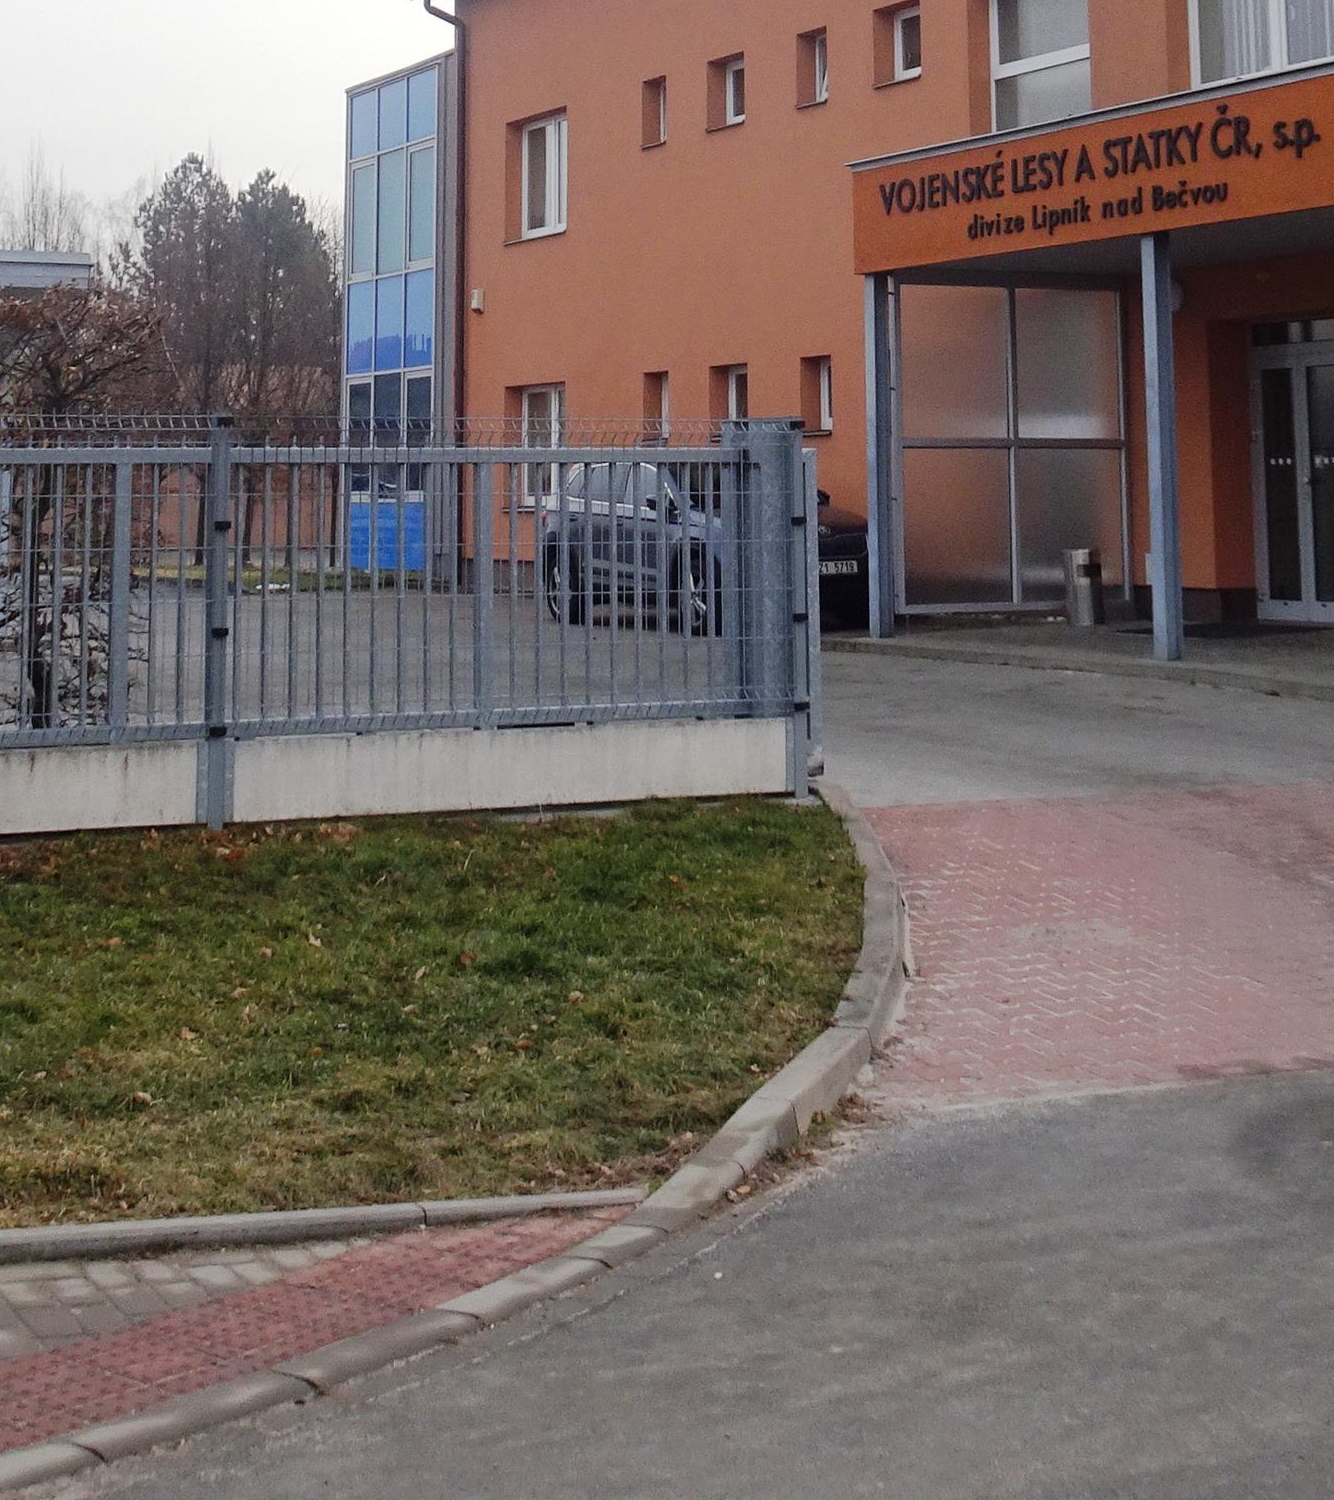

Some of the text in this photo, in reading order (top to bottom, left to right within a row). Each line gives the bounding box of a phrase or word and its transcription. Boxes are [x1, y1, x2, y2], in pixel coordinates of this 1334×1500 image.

[879, 104, 1321, 216] VOJENSKÉ LESY A STATKY ČR, s.p.
[968, 180, 1229, 240] divize Lipník nad Bečvou
